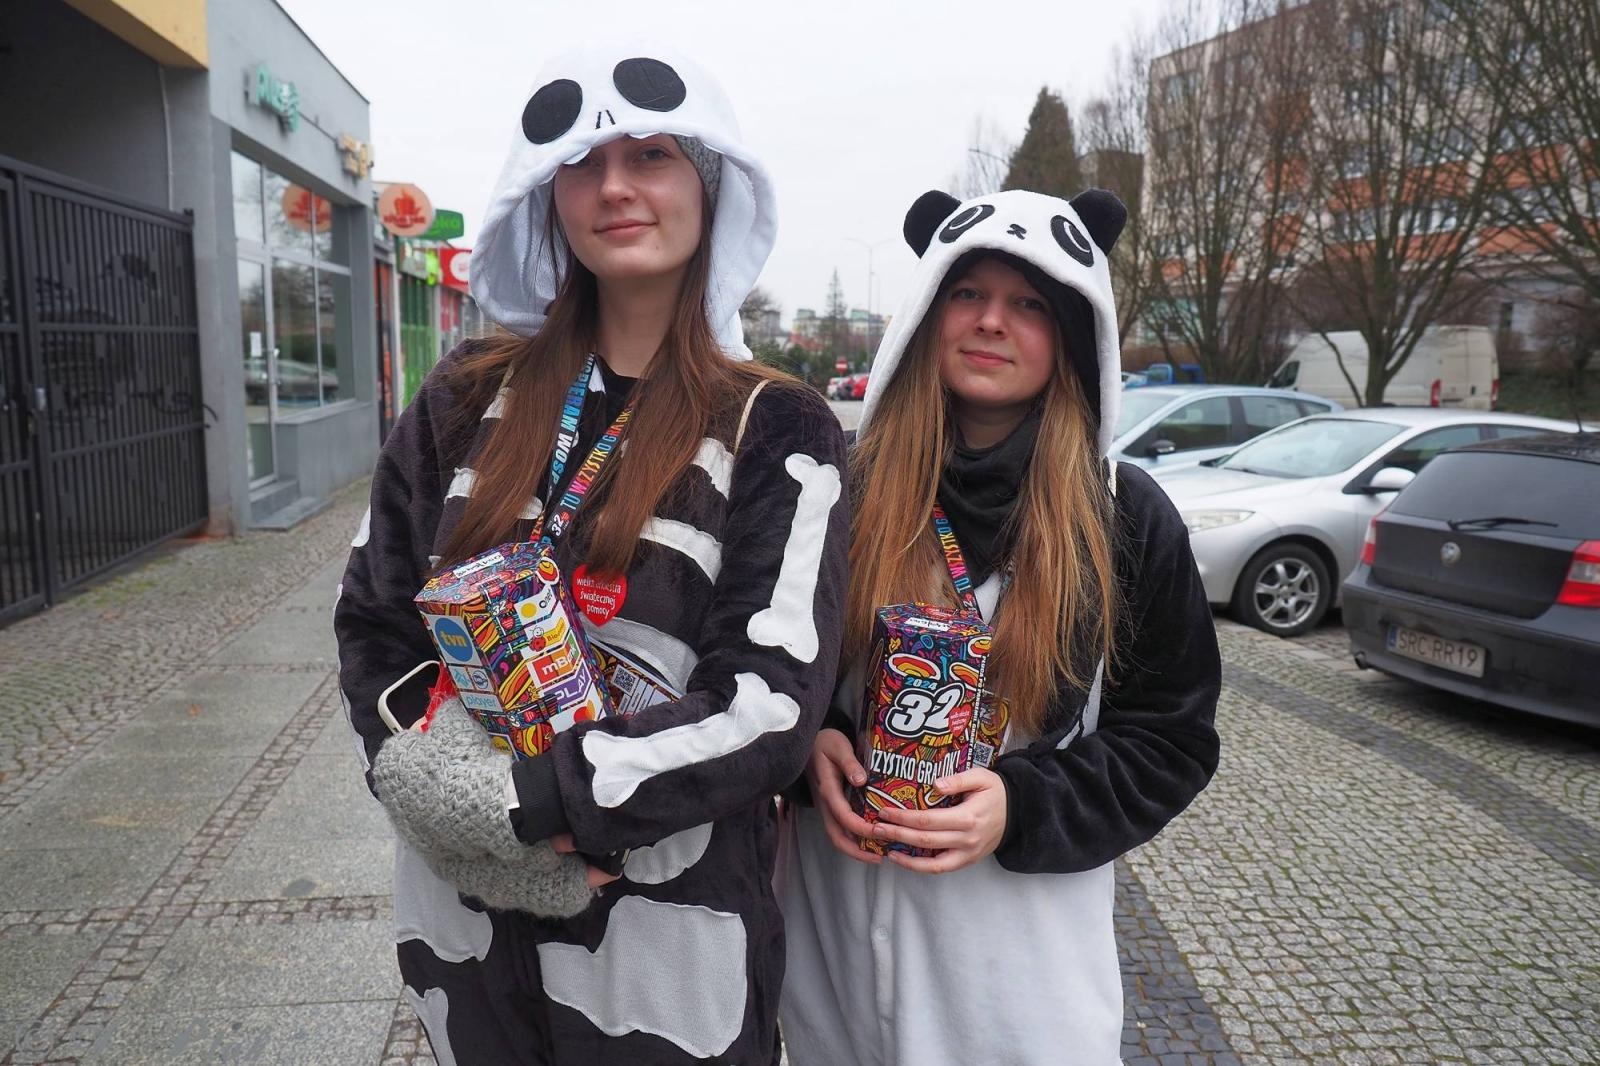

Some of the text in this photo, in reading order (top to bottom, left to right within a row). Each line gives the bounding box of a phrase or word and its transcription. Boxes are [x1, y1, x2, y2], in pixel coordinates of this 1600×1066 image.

[603, 421, 625, 444] GRA
[568, 437, 612, 496] WSZYSTKO
[560, 493, 581, 510] TU
[551, 514, 565, 537] 32
[938, 527, 968, 579] WSZYSTKO
[954, 577, 972, 593] TU
[492, 600, 507, 616] 32
[587, 604, 610, 619] pomocy
[440, 630, 468, 648] tvn
[1399, 630, 1479, 668] SRC RR19
[554, 668, 586, 701] PLAY
[905, 676, 938, 691] 2024
[889, 687, 962, 734] 32
[870, 749, 916, 781] SZYSTKO
[942, 749, 961, 778] OK!
